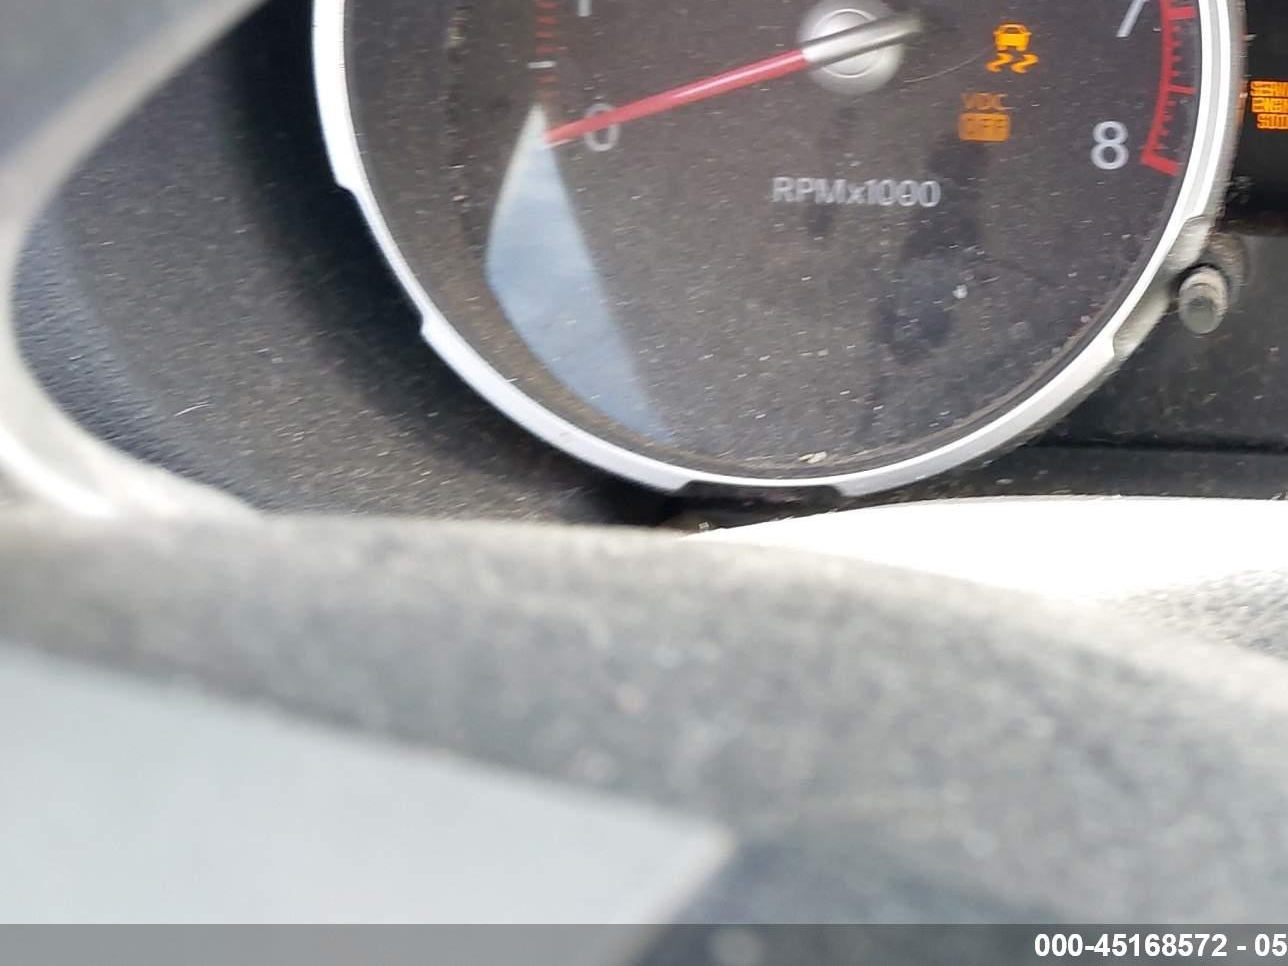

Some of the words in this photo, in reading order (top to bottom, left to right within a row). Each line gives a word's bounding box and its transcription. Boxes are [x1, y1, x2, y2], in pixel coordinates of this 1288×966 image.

[584, 102, 620, 152] 0
[1090, 120, 1130, 171] 8
[772, 176, 942, 208] RPMx1000
